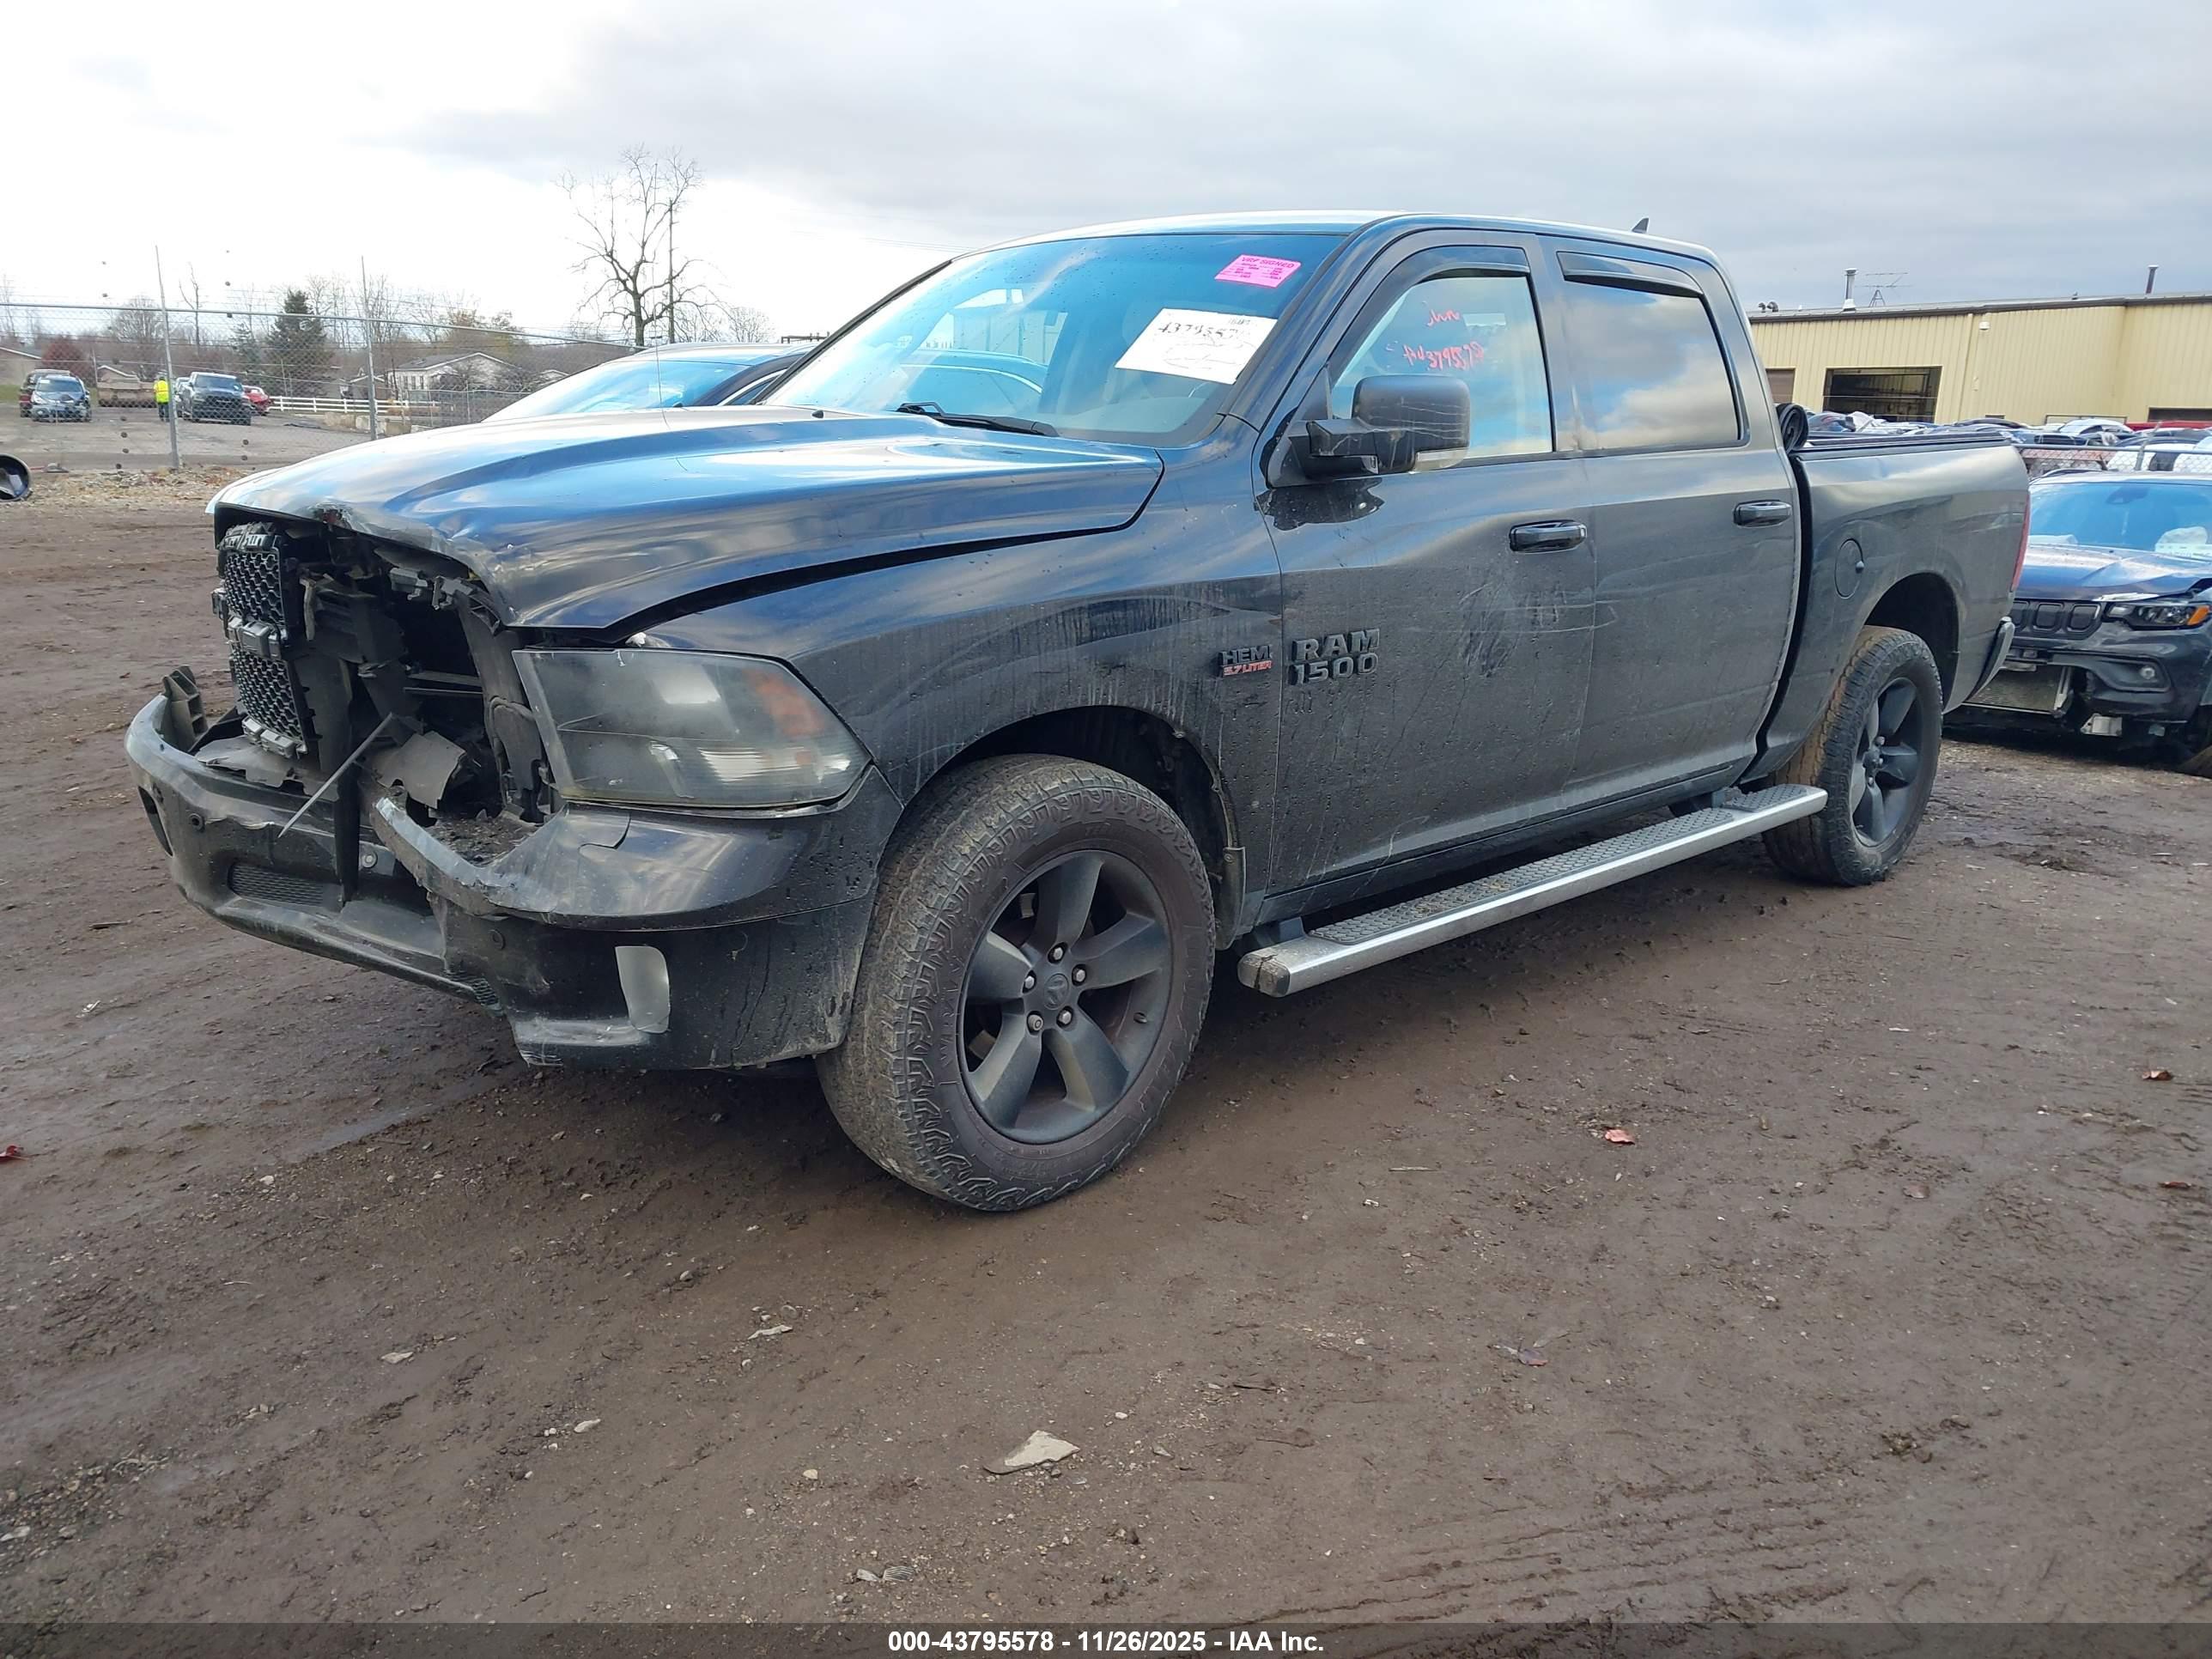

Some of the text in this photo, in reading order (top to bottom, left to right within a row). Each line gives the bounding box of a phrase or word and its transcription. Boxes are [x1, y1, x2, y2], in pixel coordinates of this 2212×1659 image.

[1259, 258, 1295, 269] SIGNED
[1291, 627, 1381, 662] RAM
[1242, 660, 1273, 673] LITER
[1290, 652, 1379, 685] 1500
